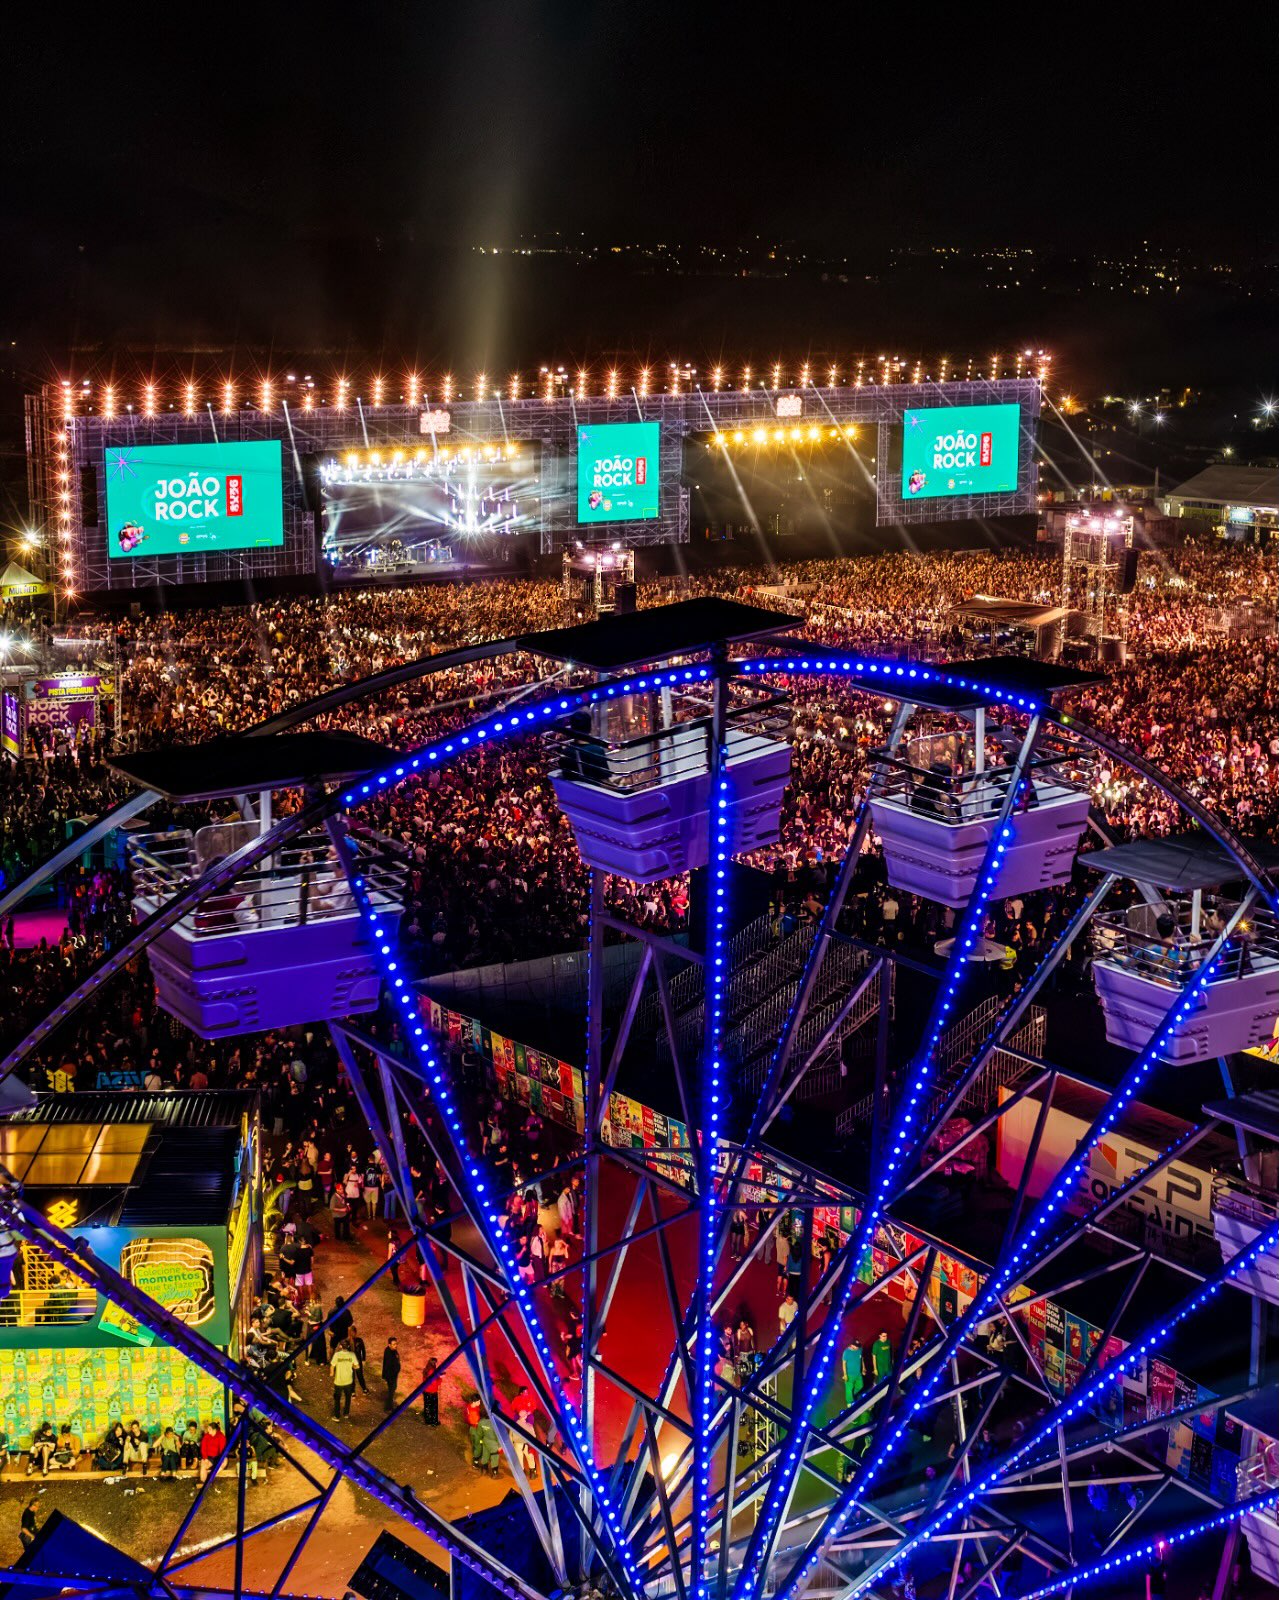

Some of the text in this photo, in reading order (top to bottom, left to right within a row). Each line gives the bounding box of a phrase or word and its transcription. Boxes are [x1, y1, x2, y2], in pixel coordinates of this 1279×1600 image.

[934, 429, 977, 452] JOÃO
[593, 454, 633, 473] JOÃO
[933, 451, 976, 469] ROCK
[154, 472, 220, 499] JOÃO
[593, 472, 632, 488] ROCK
[155, 499, 219, 521] ROCK
[28, 711, 70, 724] ROCK
[139, 1272, 200, 1285] momentos
